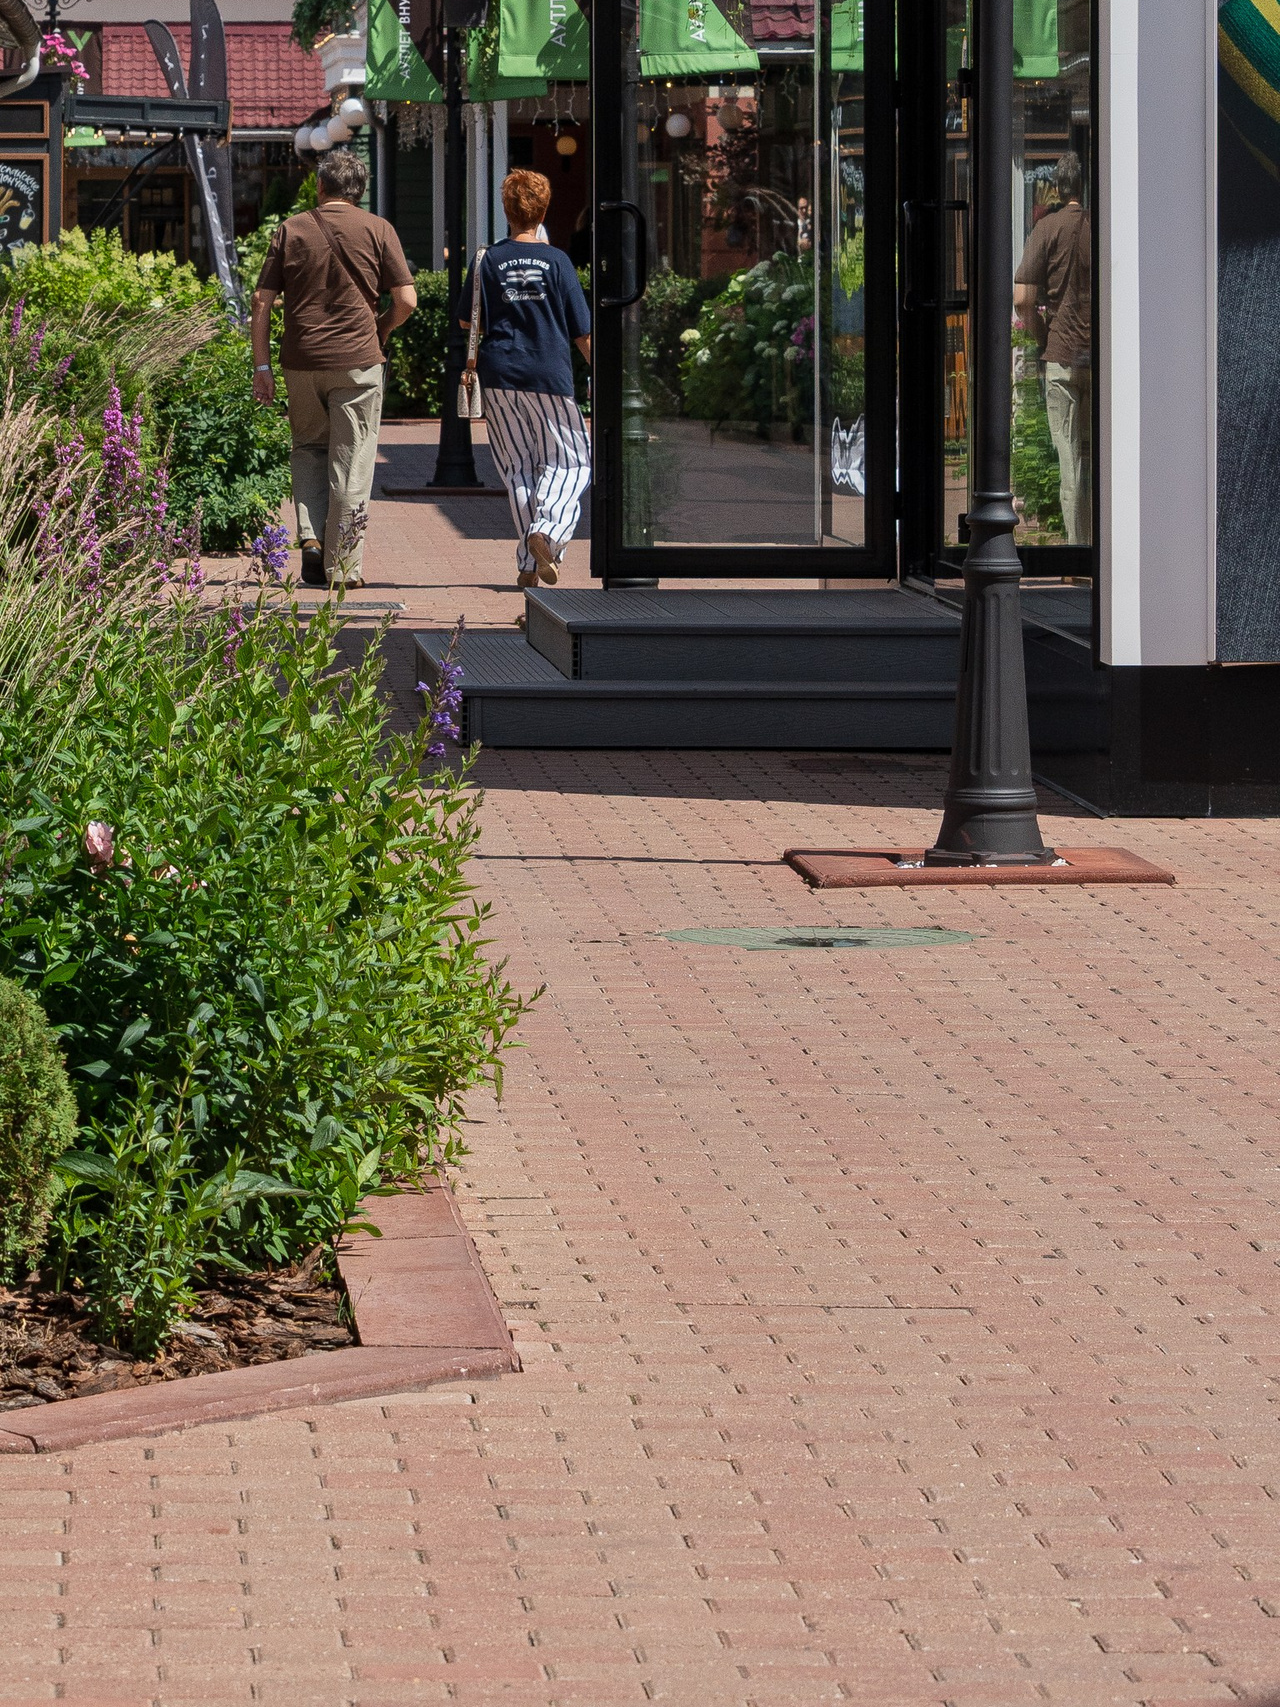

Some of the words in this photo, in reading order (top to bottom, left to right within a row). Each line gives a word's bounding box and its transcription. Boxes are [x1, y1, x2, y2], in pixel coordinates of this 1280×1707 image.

[398, 29, 412, 81] АУТЛЕТ
[498, 262, 508, 271] UP
[508, 259, 518, 267] TO
[532, 258, 550, 270] SKIES
